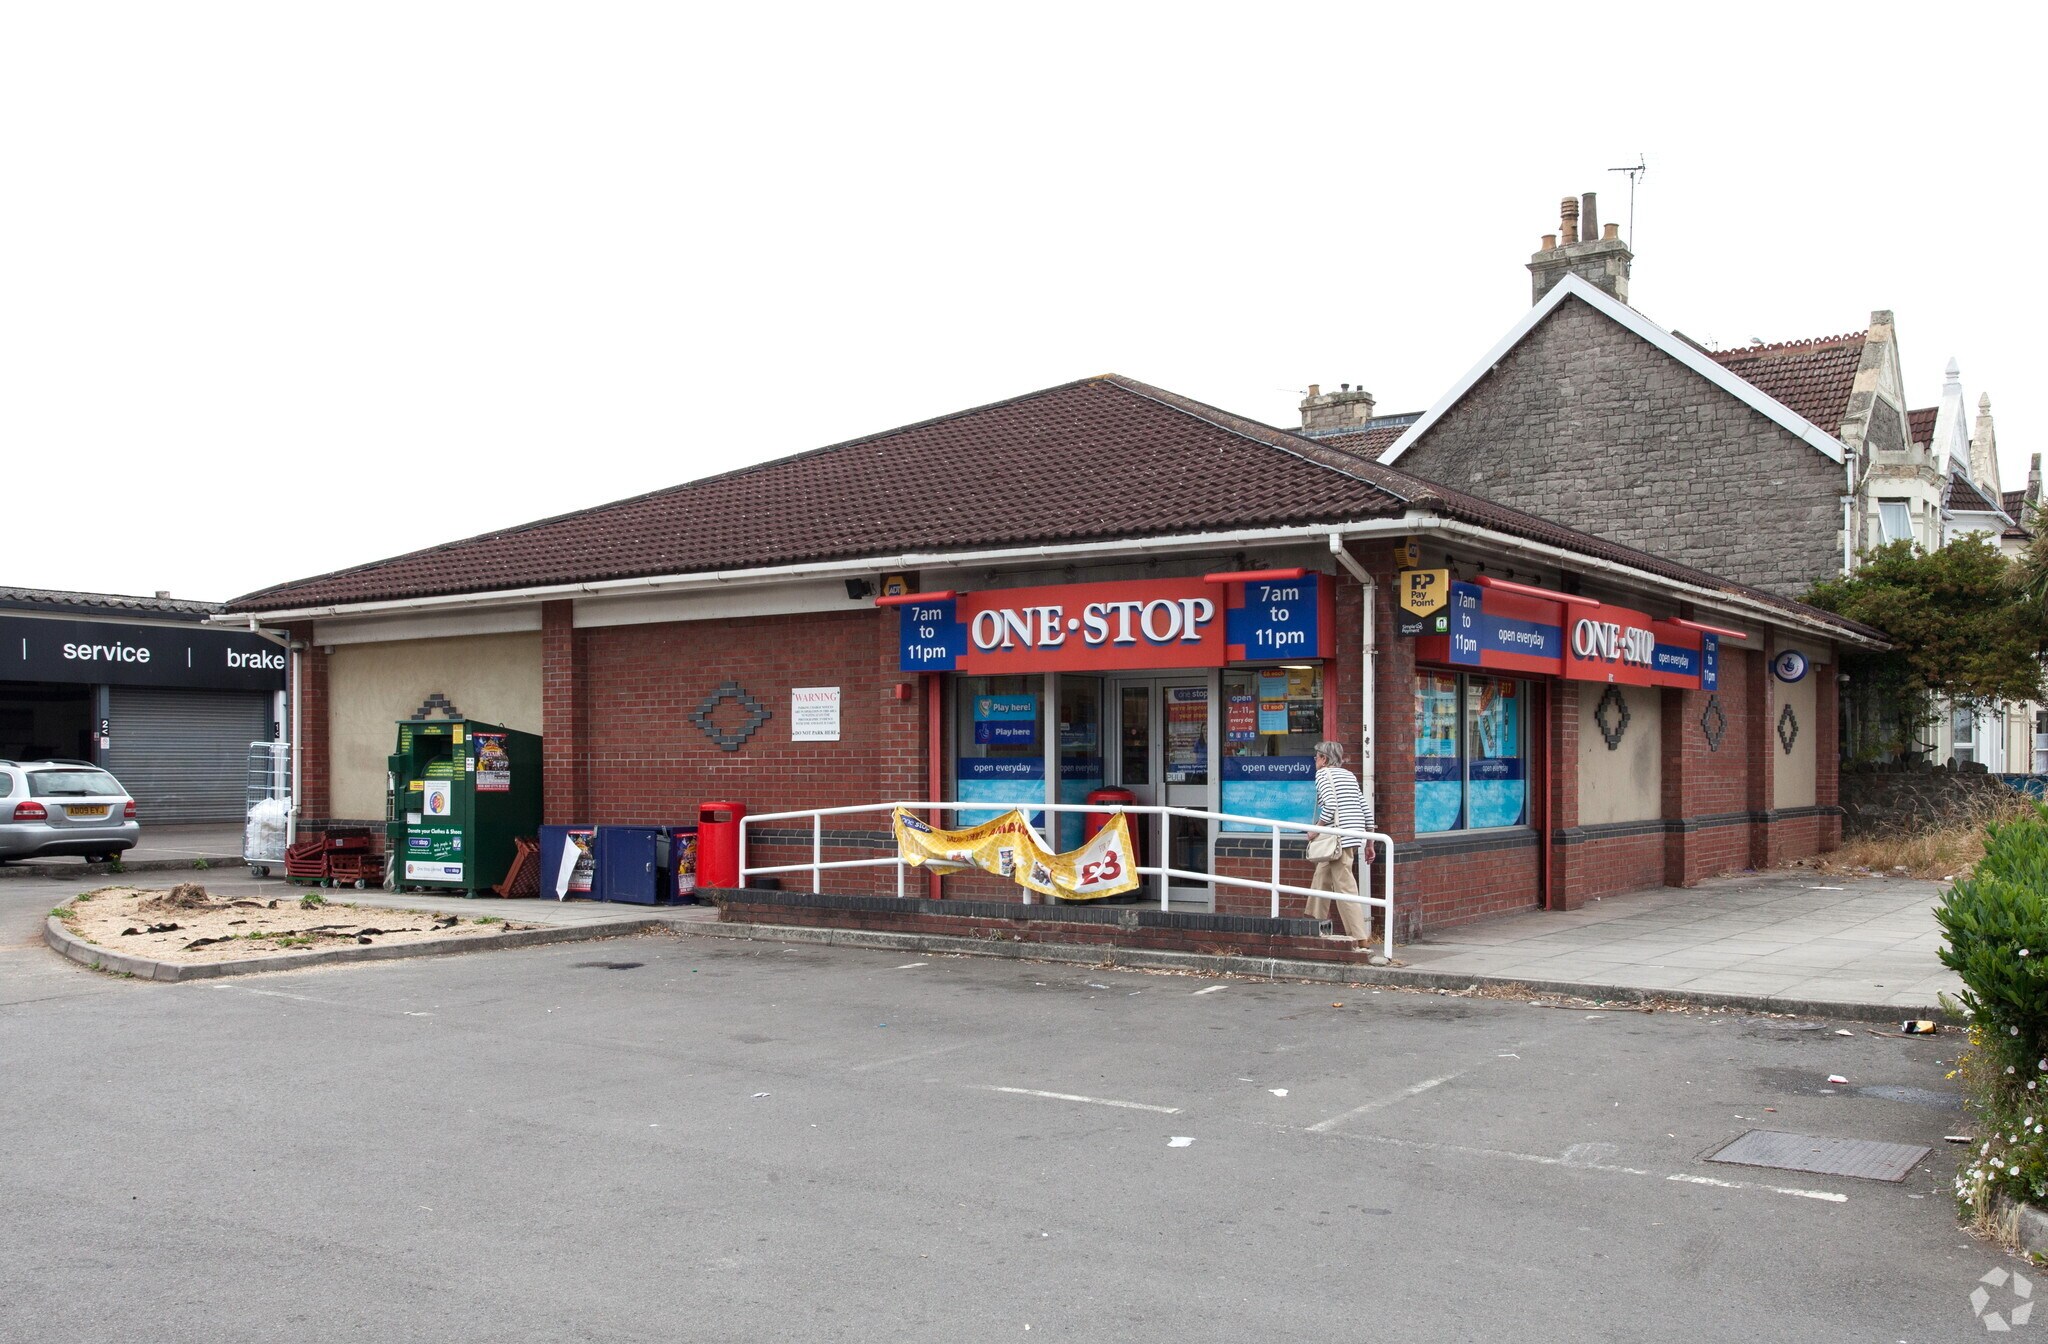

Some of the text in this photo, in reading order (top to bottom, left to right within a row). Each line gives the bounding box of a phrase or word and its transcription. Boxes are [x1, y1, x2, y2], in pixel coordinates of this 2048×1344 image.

[889, 586, 900, 594] ADT
[1260, 586, 1299, 602] 7am
[1411, 591, 1426, 600] Pay
[1458, 591, 1476, 608] 7am
[911, 607, 942, 622] 7am
[1083, 598, 1216, 644] STOP
[1270, 606, 1290, 622] to
[1462, 612, 1471, 628] to
[919, 625, 934, 638] to
[1256, 628, 1304, 649] 11pm
[1455, 634, 1476, 654] 11pm
[1498, 629, 1544, 649] open everyday
[1706, 639, 1715, 652] 7am
[63, 641, 285, 670] service brake
[908, 644, 946, 662] 11pm
[1658, 652, 1689, 669] open everyday
[1708, 656, 1713, 665] to
[1704, 670, 1716, 684] 11pm
[795, 692, 837, 702] WARNING
[993, 703, 1031, 712] Play here!
[102, 720, 108, 728] 2
[996, 728, 1012, 736] Play
[974, 763, 1031, 773] open everyday
[1060, 764, 1074, 773] open
[1242, 762, 1311, 774] open everyday
[1415, 763, 1443, 774] pen everyday
[1080, 850, 1121, 885] £3
